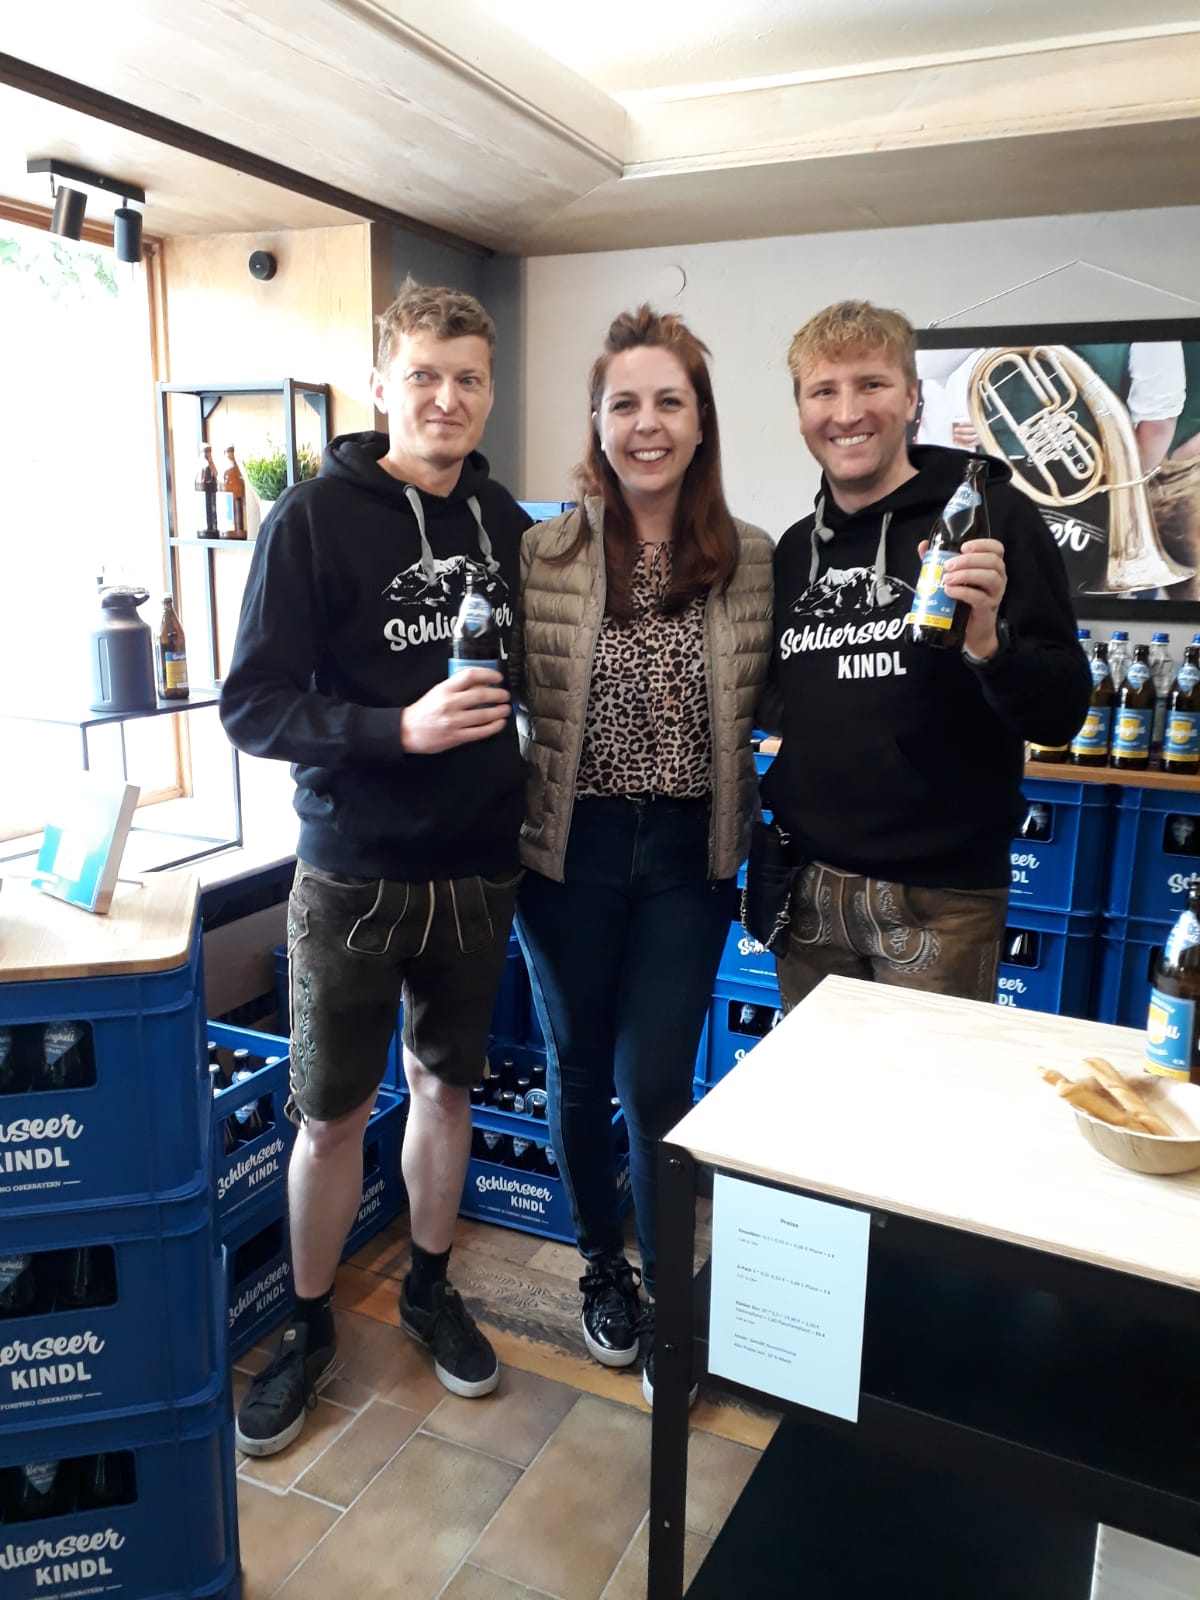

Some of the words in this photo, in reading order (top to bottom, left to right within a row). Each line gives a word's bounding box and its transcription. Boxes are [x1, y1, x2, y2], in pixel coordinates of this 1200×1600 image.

[837, 651, 907, 680] KINDL
[217, 1137, 285, 1200] Schlierseer
[248, 1159, 279, 1188] KINDL
[475, 1175, 553, 1202] Schlierseer
[510, 1195, 546, 1214] KINDL
[256, 1282, 286, 1313] KINDL
[0, 1331, 105, 1367] erseer
[11, 1361, 92, 1391] KINDL
[35, 1557, 113, 1587] KINDL
